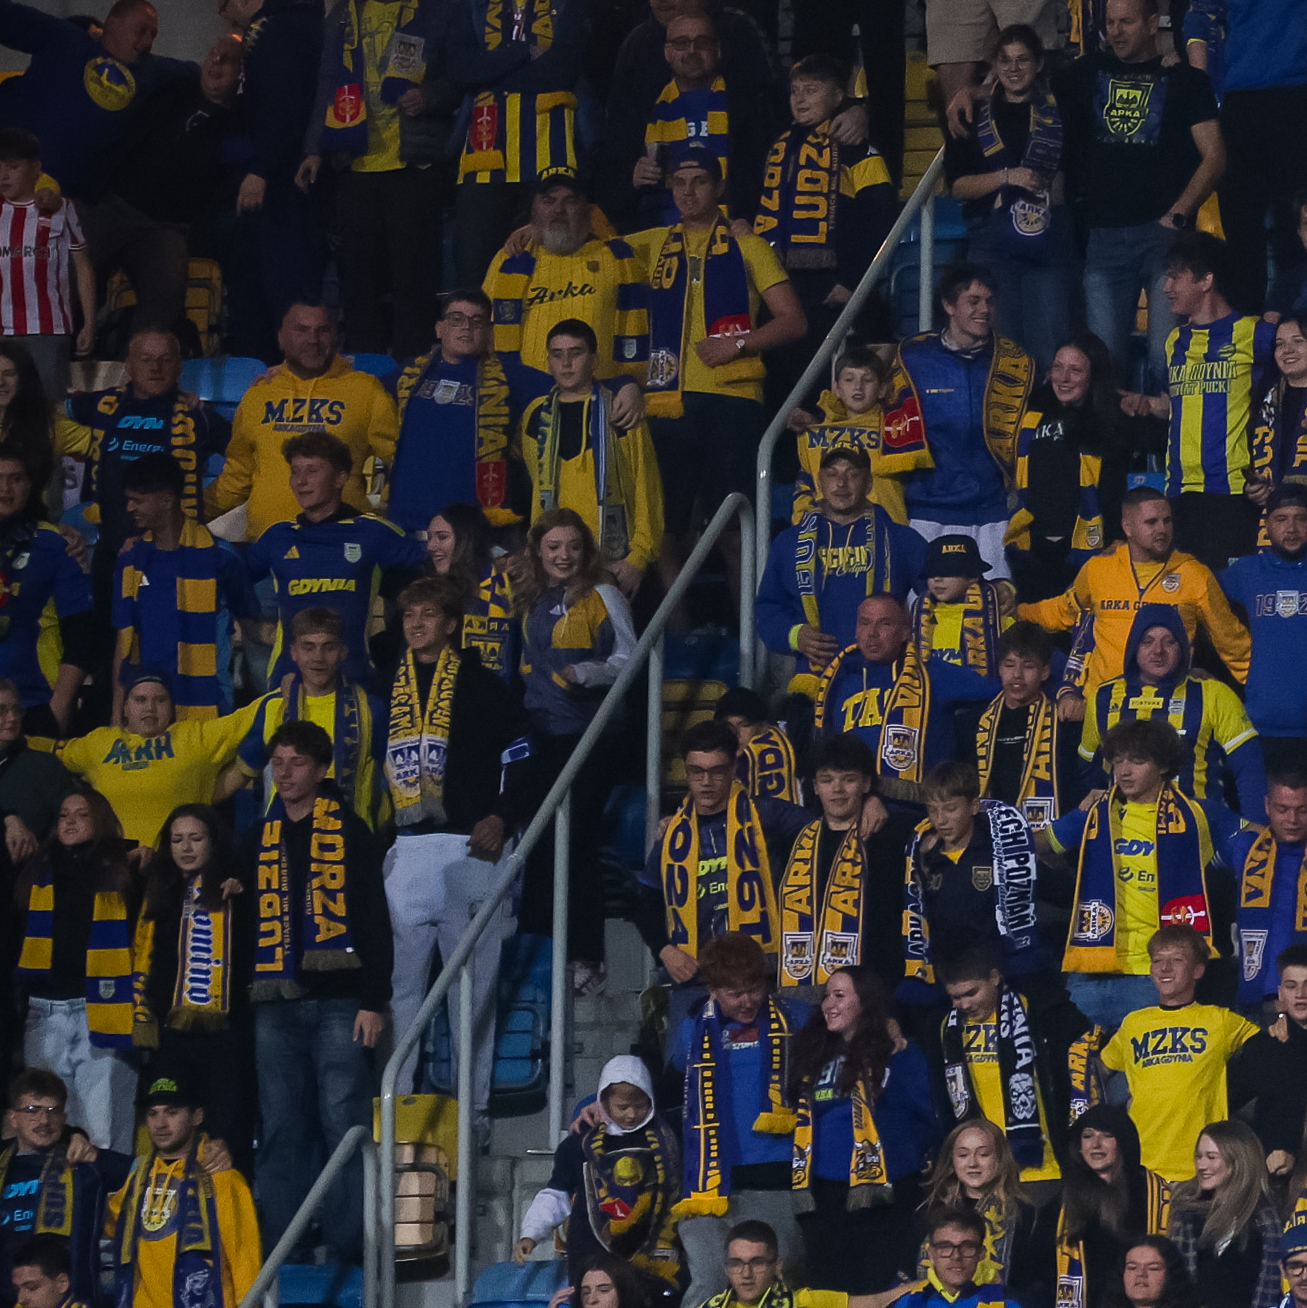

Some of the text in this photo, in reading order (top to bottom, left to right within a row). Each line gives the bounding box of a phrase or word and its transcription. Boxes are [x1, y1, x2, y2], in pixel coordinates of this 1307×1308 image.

[1108, 109, 1143, 120] ARKA
[527, 283, 595, 305] Arka
[264, 398, 345, 426] MZKS
[808, 430, 880, 449] MZKS
[288, 579, 355, 596] GDYNIA
[1100, 598, 1131, 611] ARKA
[888, 746, 914, 757] ARKA
[1115, 838, 1155, 855] GDY
[309, 798, 347, 943] MORZA
[255, 820, 284, 972] LUDZIE
[1009, 853, 1034, 928] POZNAŃ
[1090, 905, 1099, 940] ARKA
[1131, 1027, 1207, 1058] MZKS
